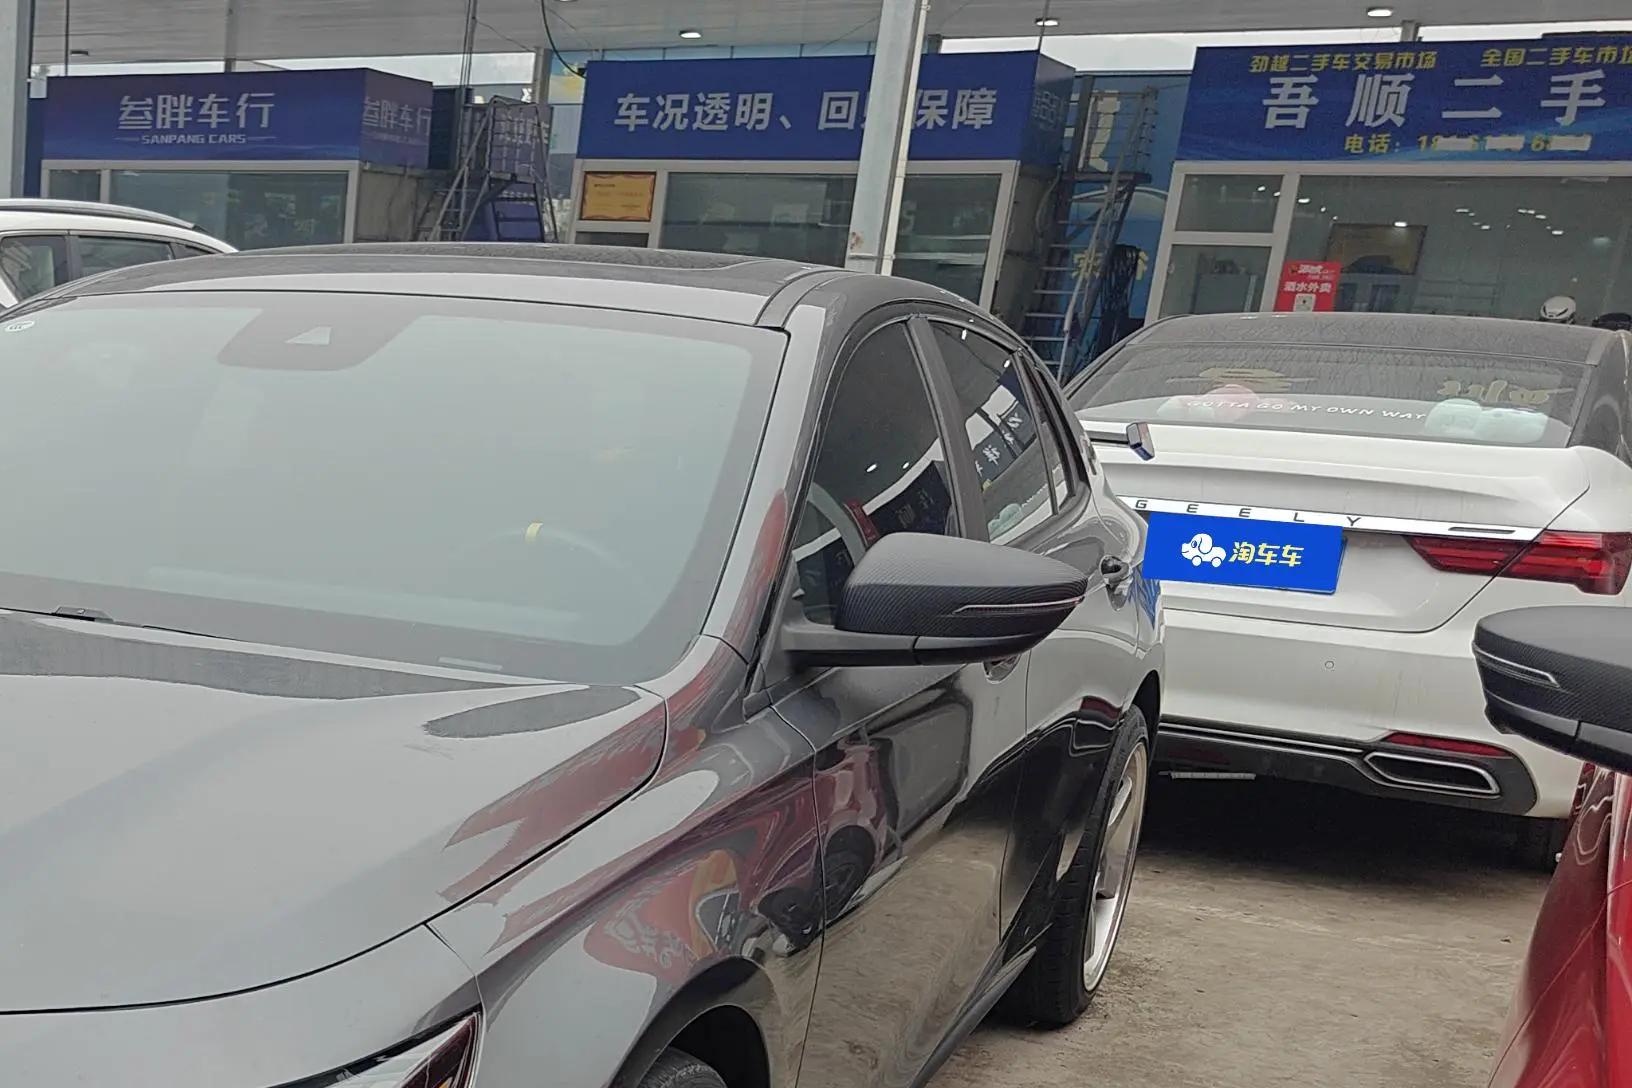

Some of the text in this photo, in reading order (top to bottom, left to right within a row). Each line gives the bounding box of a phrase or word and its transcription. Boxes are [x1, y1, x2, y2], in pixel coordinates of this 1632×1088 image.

[1248, 50, 1439, 73] 劲越二手车交易市场
[118, 92, 276, 131] 叁胖车行
[613, 87, 999, 132] 车况透明、回保障
[1262, 68, 1607, 129] 吾顺二手
[141, 134, 246, 145] SANPANG CARS
[1187, 399, 1428, 421] GOTTA GO MY OWN WAY
[1134, 499, 1363, 528] GEELY
